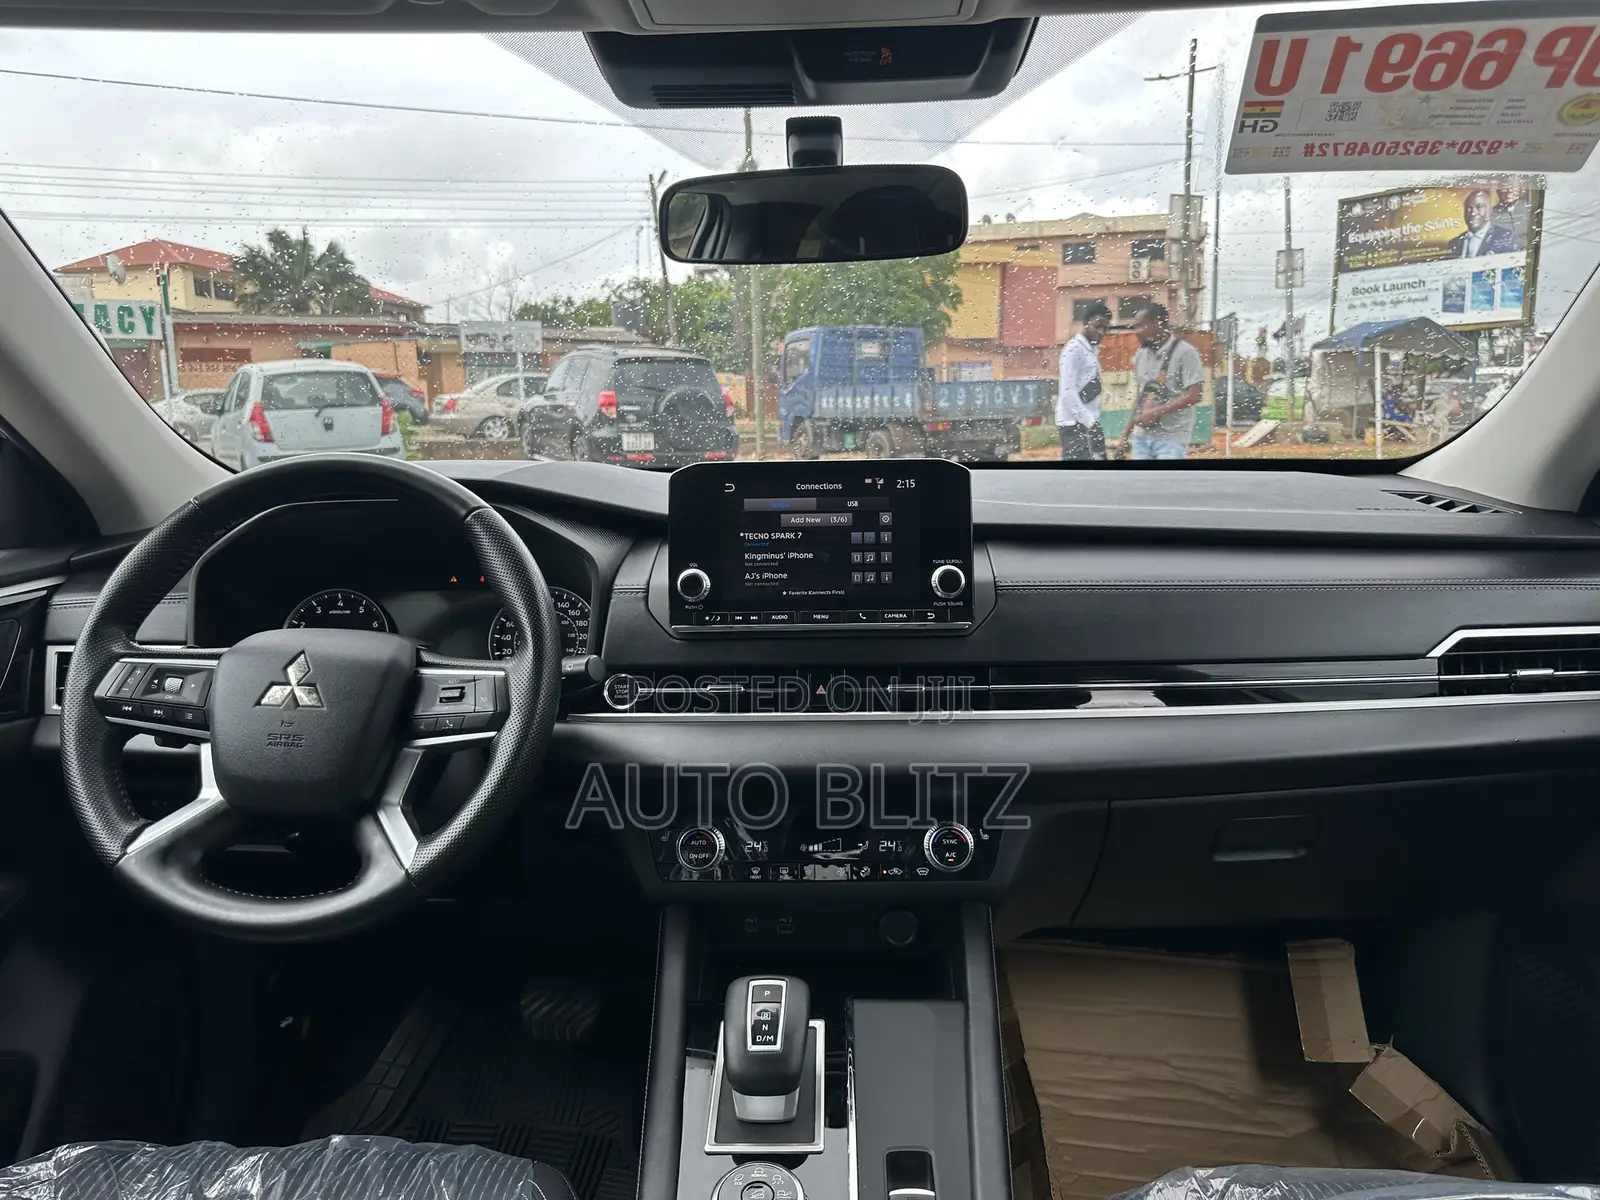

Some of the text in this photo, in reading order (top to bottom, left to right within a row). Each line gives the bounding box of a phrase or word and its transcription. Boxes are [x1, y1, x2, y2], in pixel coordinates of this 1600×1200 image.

[1351, 278, 1427, 297] Book Launch
[74, 303, 157, 335] ACY
[795, 482, 843, 491] Connections
[896, 479, 916, 489] 2:15
[790, 516, 804, 524] Add
[744, 551, 814, 561] Kingminus' iPhone
[744, 571, 788, 580] AJ's iPhone
[557, 601, 570, 609] 140
[315, 606, 322, 614] 3
[358, 606, 365, 614] 5
[372, 620, 379, 628] 6
[575, 619, 588, 627] 180
[500, 633, 512, 641] 40
[502, 647, 513, 655] 20
[267, 732, 305, 742] SRS
[756, 1034, 774, 1043] D/M
